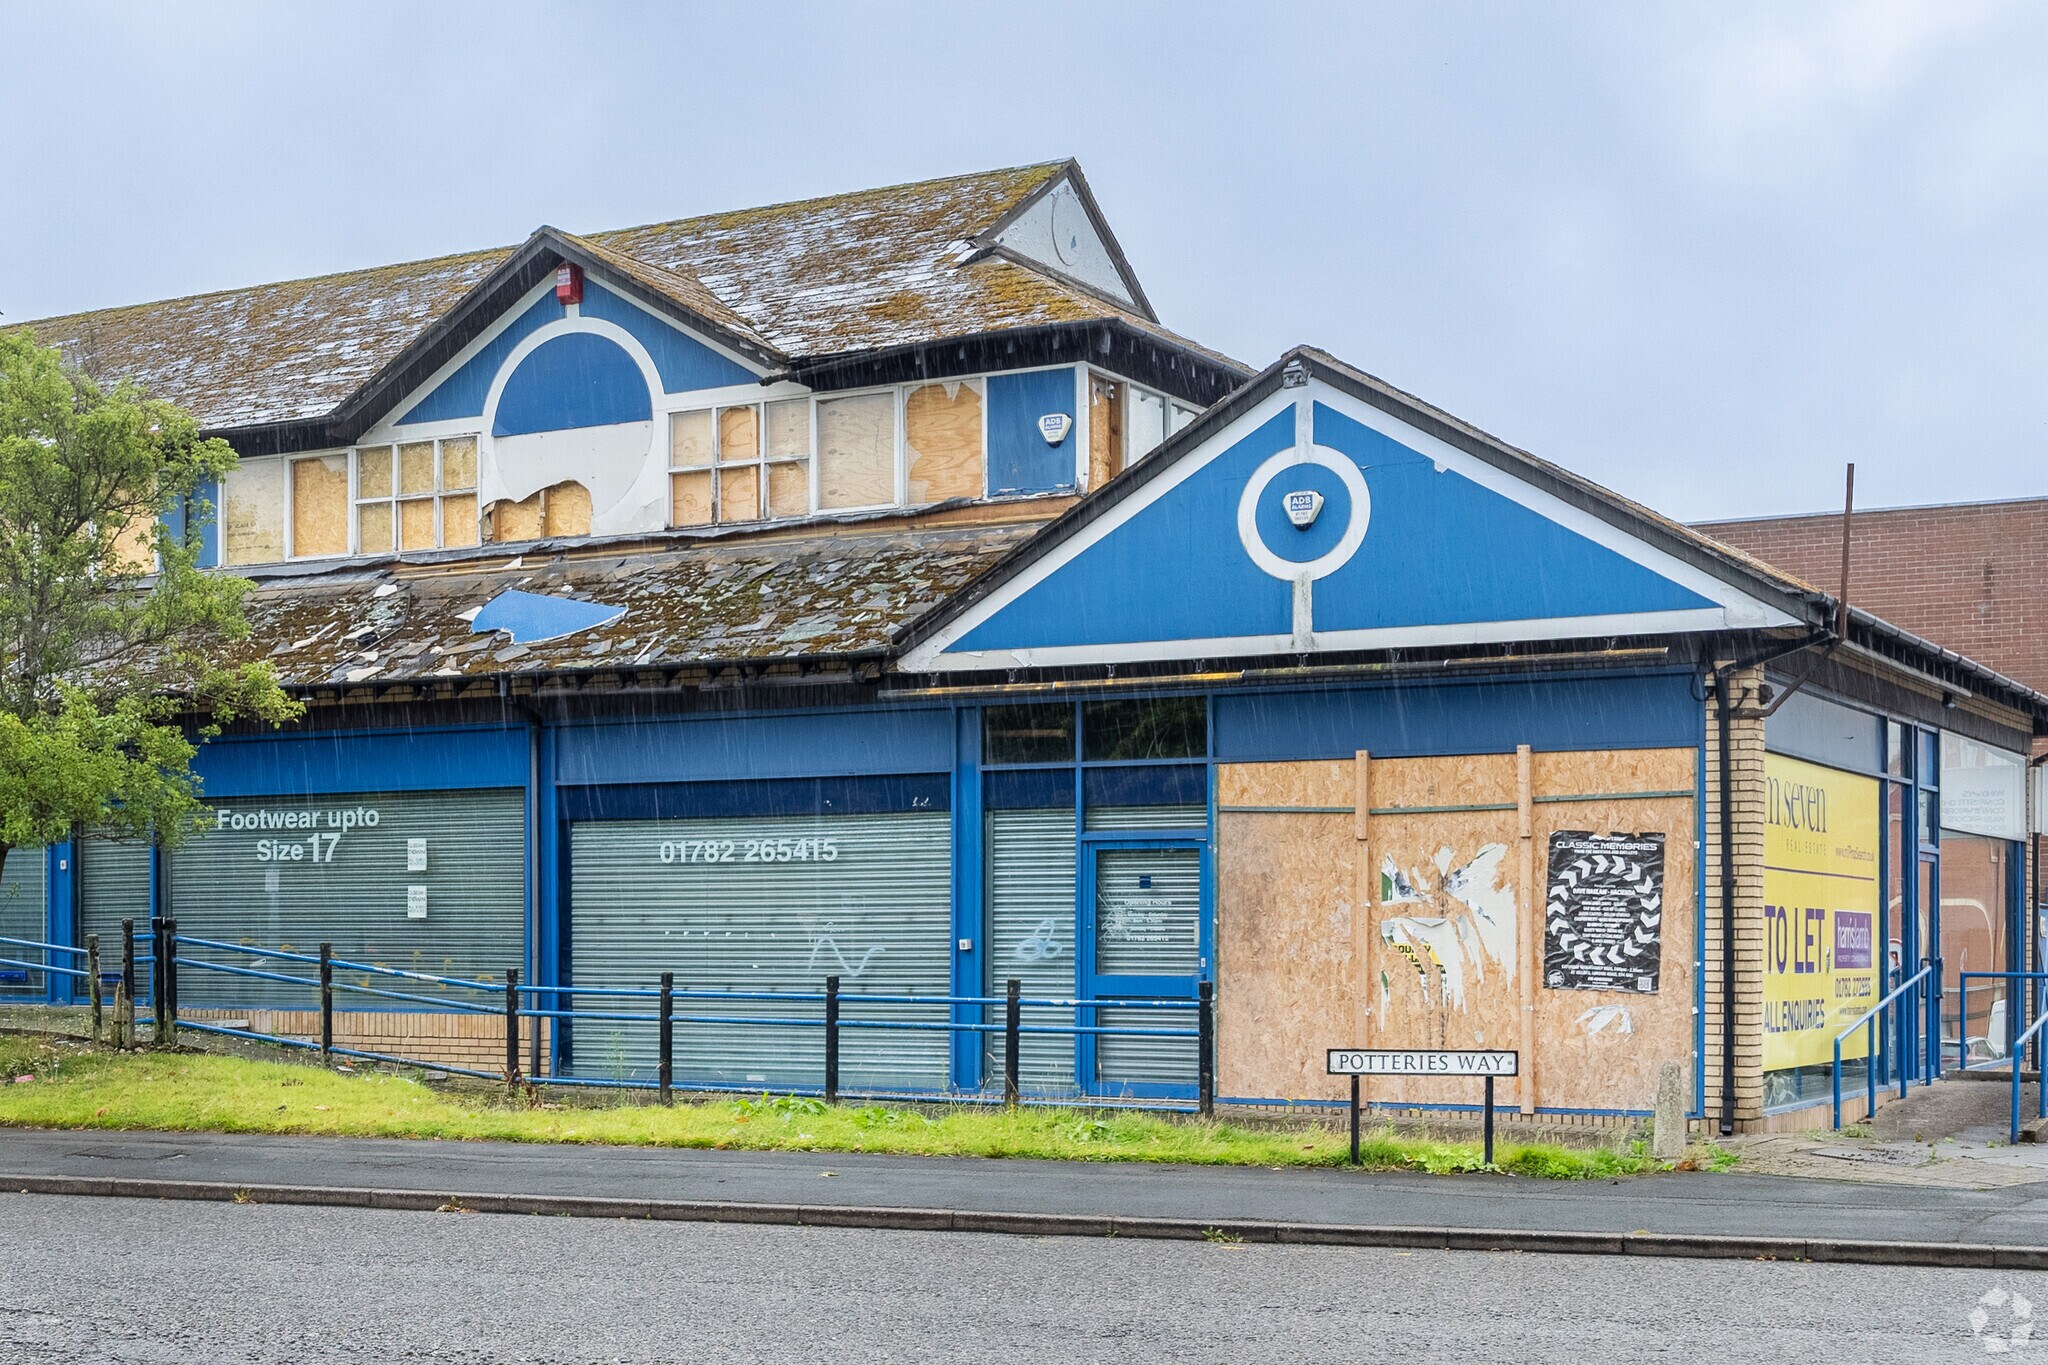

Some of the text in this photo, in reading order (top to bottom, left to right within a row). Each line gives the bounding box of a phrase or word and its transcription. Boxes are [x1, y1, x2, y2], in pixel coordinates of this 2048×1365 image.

[1045, 417, 1061, 425] ADB
[1292, 496, 1311, 505] ADB
[1784, 780, 1827, 833] seven
[217, 807, 380, 832] Footwear upto
[256, 832, 341, 862] Size 17
[660, 838, 838, 864] 01782 265415
[1555, 841, 1658, 851] CLASSIC MEMORIES
[1764, 905, 1825, 974] TO LET
[1763, 998, 1825, 1033] ALL ENQUIRIES
[1339, 1054, 1504, 1070] POTTERIES WAY
